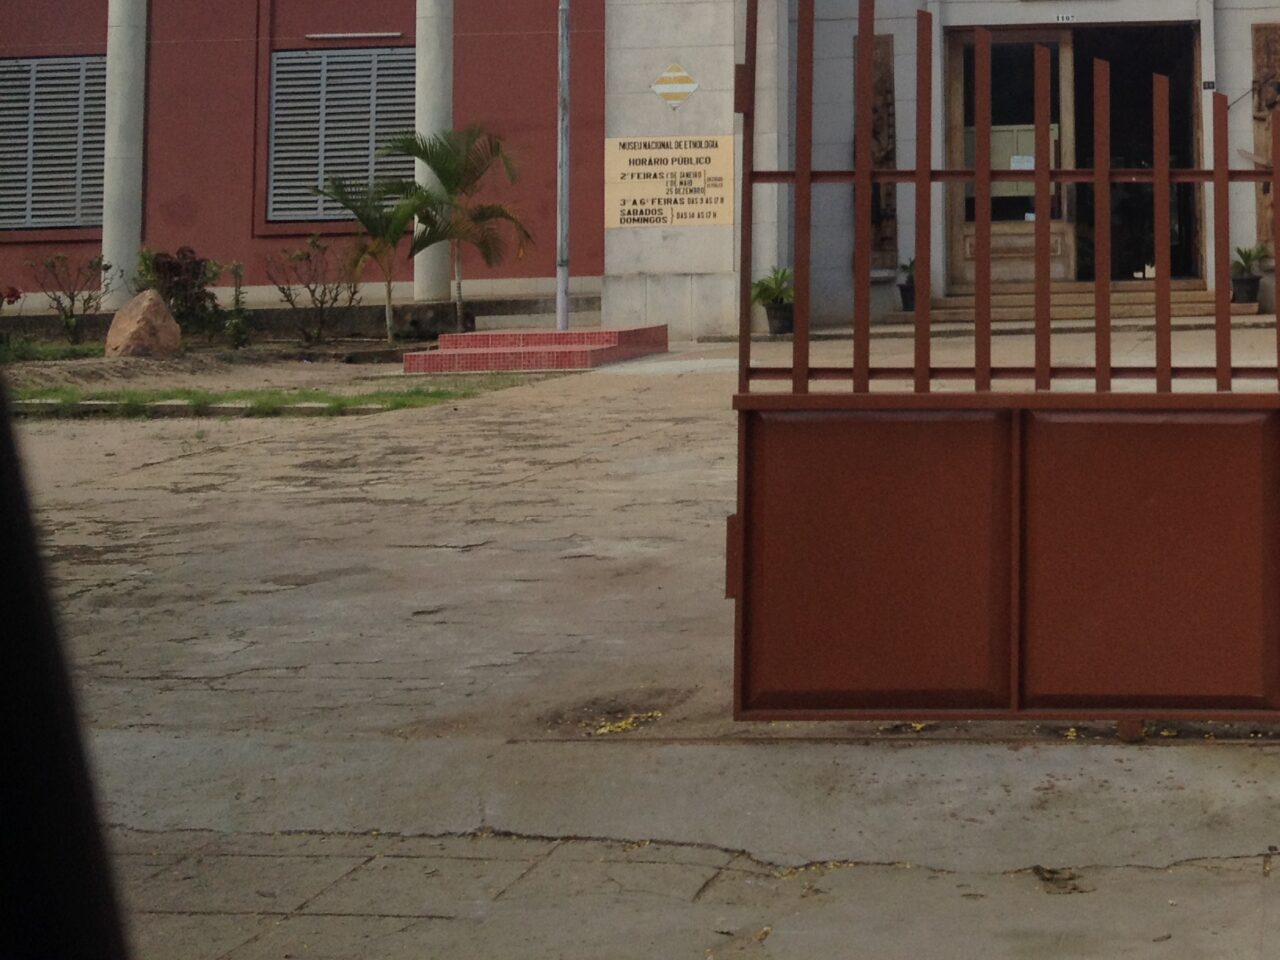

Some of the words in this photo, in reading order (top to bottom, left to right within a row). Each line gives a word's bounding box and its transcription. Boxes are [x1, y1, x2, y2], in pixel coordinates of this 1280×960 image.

[619, 141, 642, 151] MUSEU
[643, 141, 673, 150] NACIONAL
[674, 140, 683, 149] DE
[684, 139, 719, 149] ETNOLOGIA
[630, 172, 665, 180] FEIRAS
[651, 197, 685, 205] FEIRAS
[620, 216, 668, 225] DOMINGOS
